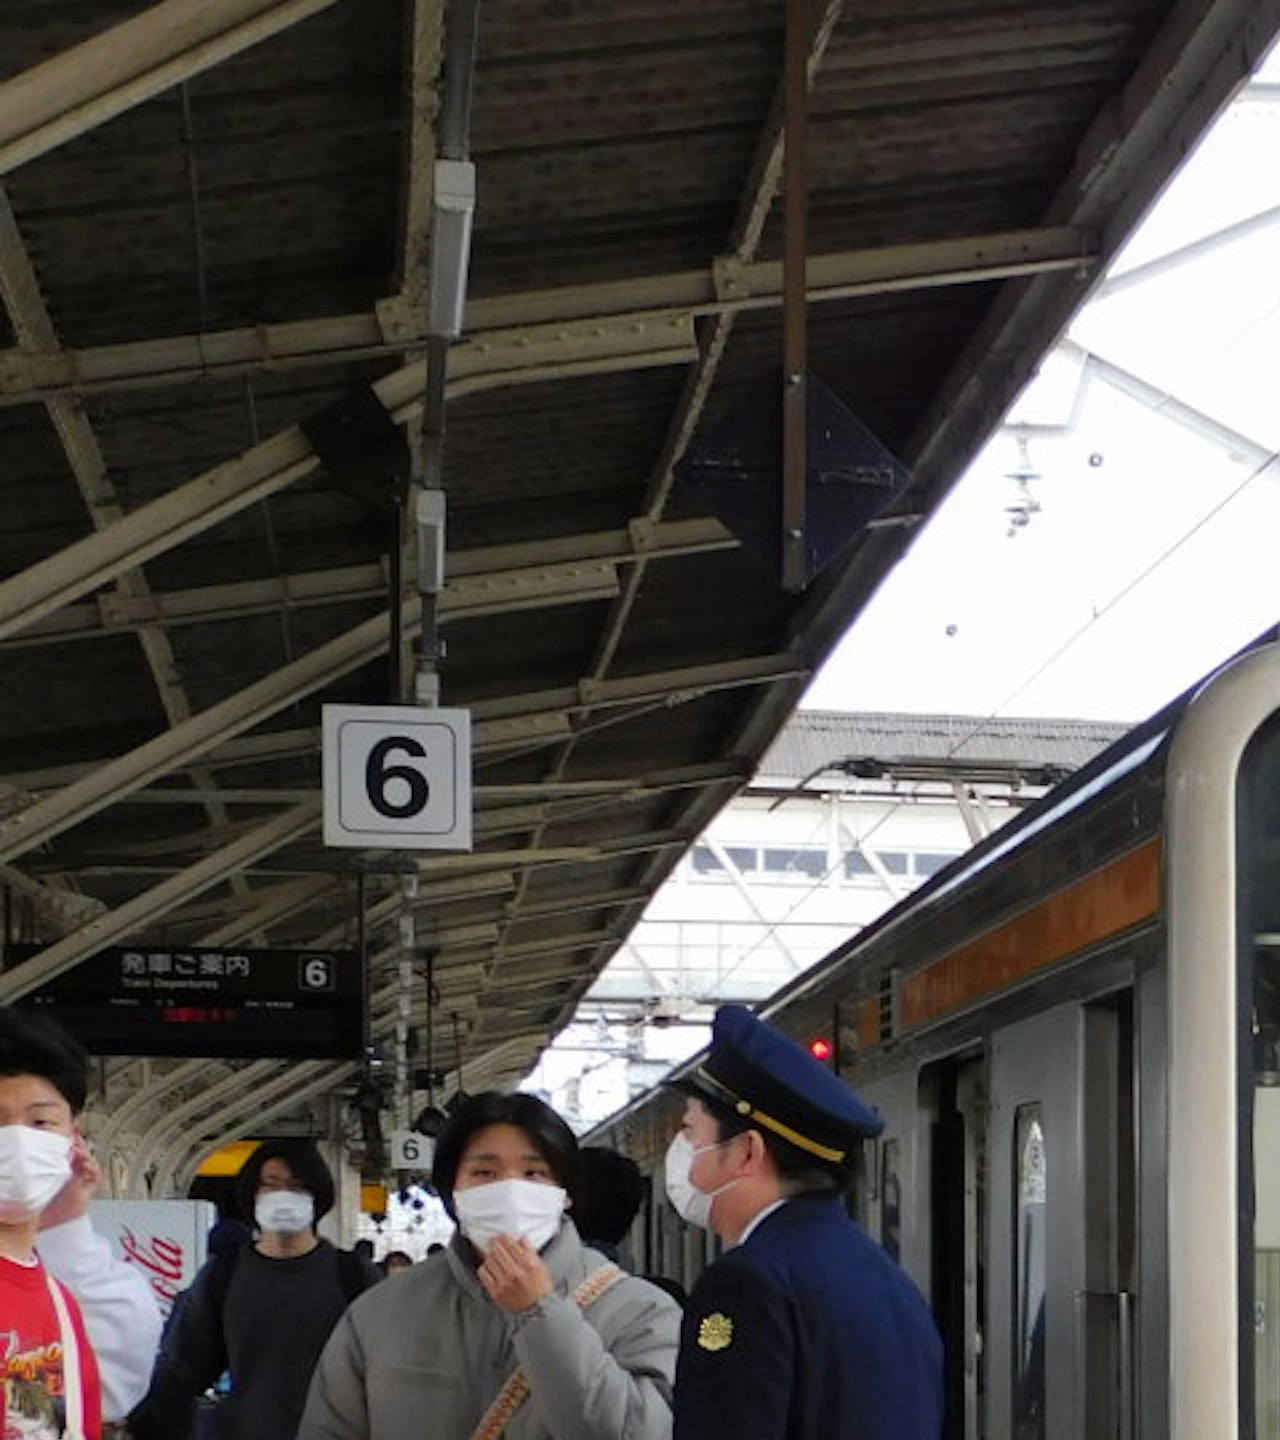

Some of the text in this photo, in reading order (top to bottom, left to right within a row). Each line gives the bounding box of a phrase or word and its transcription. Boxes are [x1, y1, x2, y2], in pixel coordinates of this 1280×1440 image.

[366, 736, 429, 819] 6
[121, 952, 250, 977] 発車ご案内
[305, 959, 328, 987] 6
[403, 1138, 420, 1161] 6
